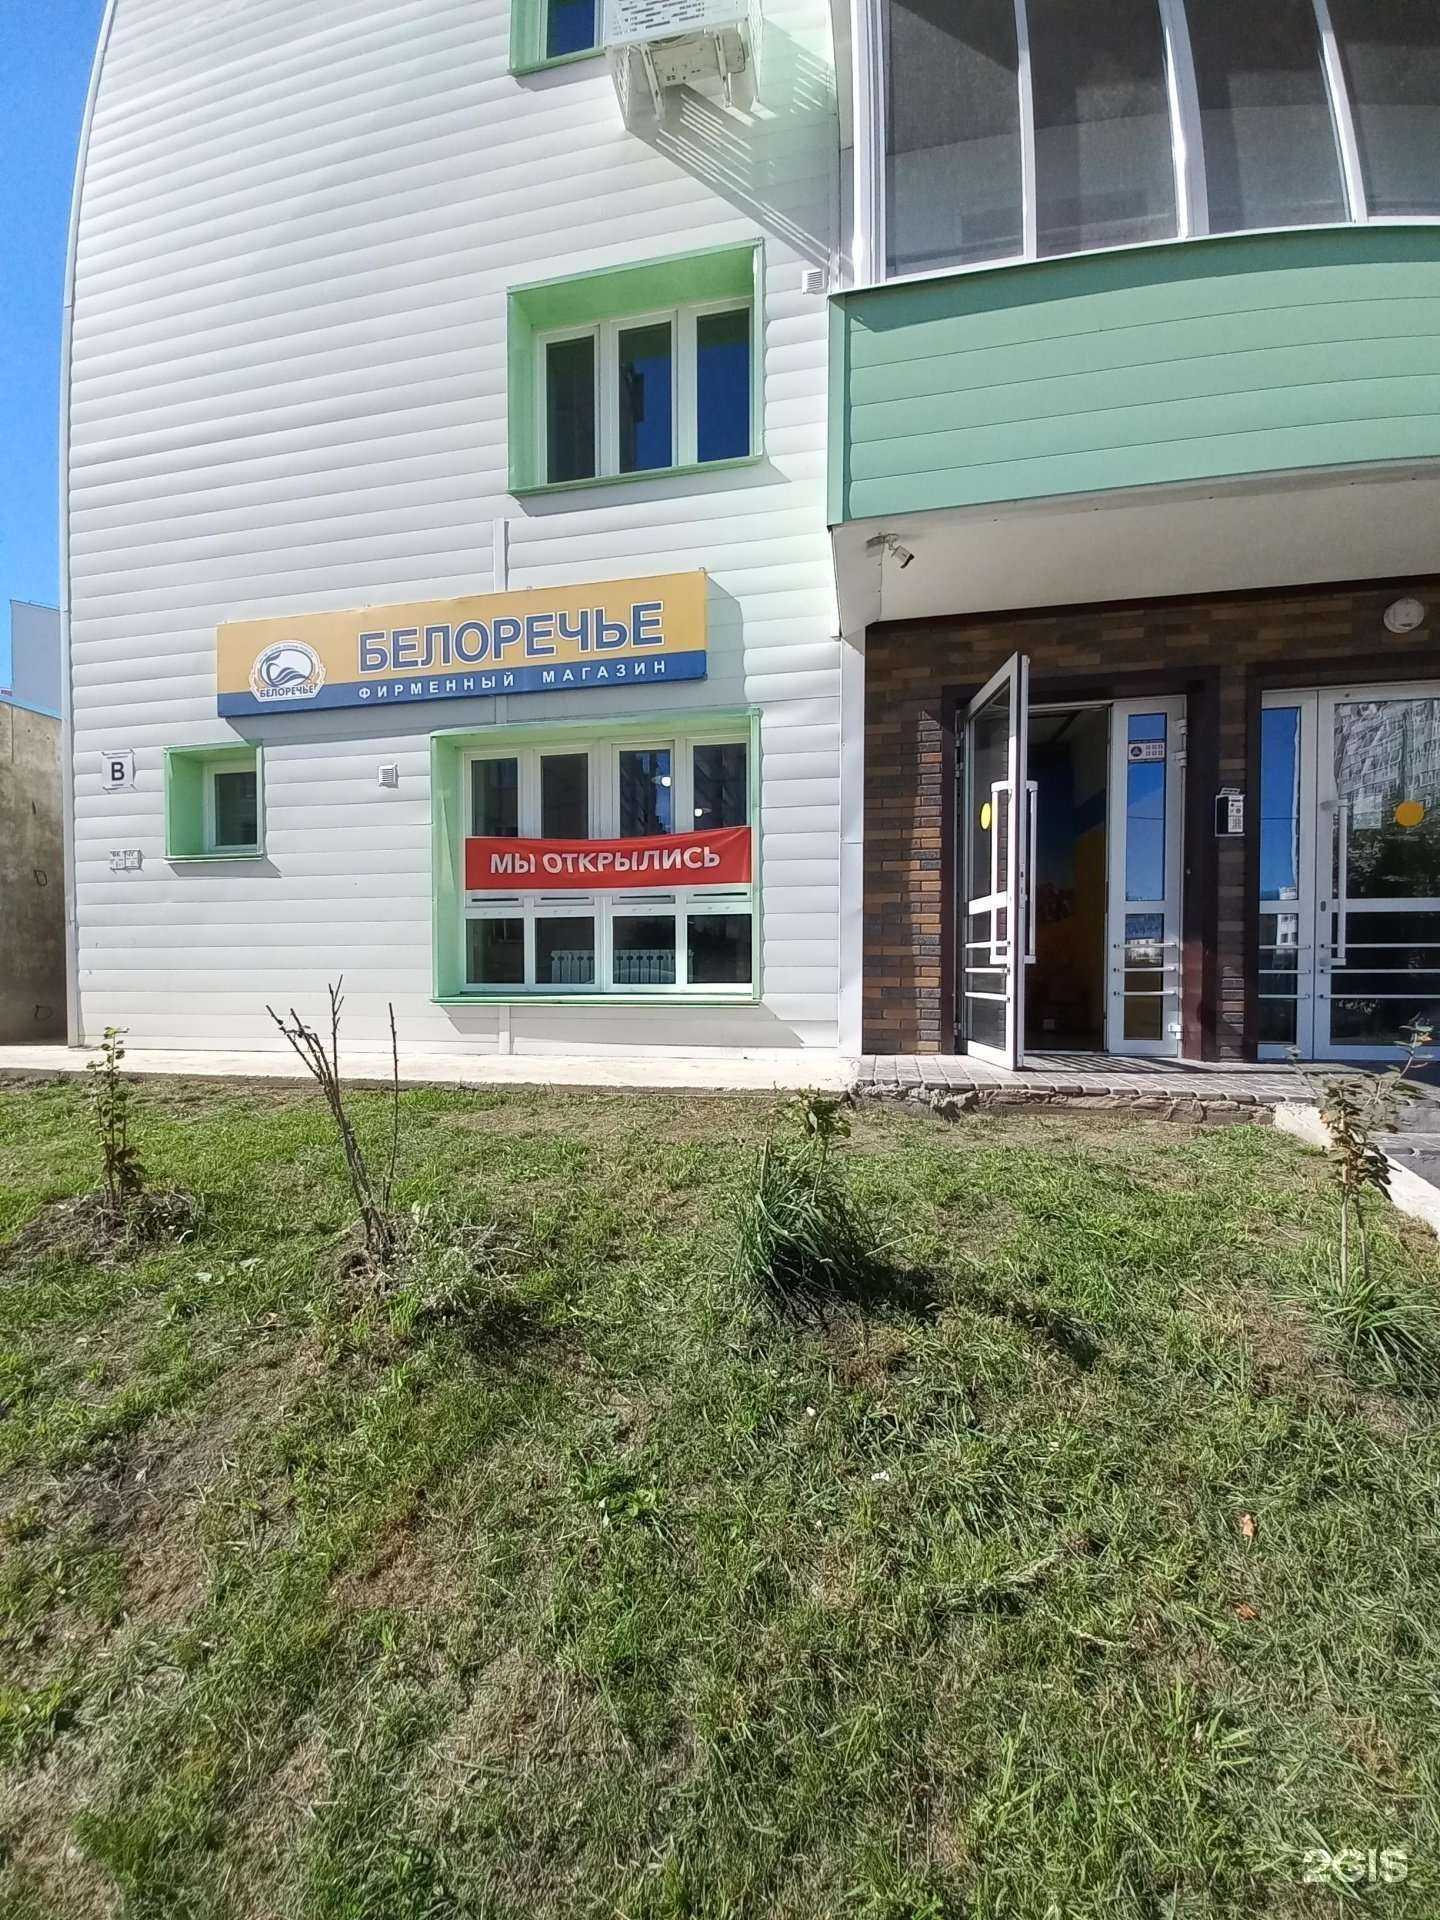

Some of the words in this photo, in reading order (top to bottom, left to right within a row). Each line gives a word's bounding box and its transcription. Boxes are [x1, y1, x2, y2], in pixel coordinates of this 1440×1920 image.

[358, 601, 665, 674] БЕЛОРЕЧЬЕ
[359, 672, 514, 699] ФИРМЕННЫЙ
[542, 660, 666, 683] МАГАЗИН
[490, 853, 536, 874] МЫ
[542, 846, 721, 874] ОТКРЫЛИСЬ
